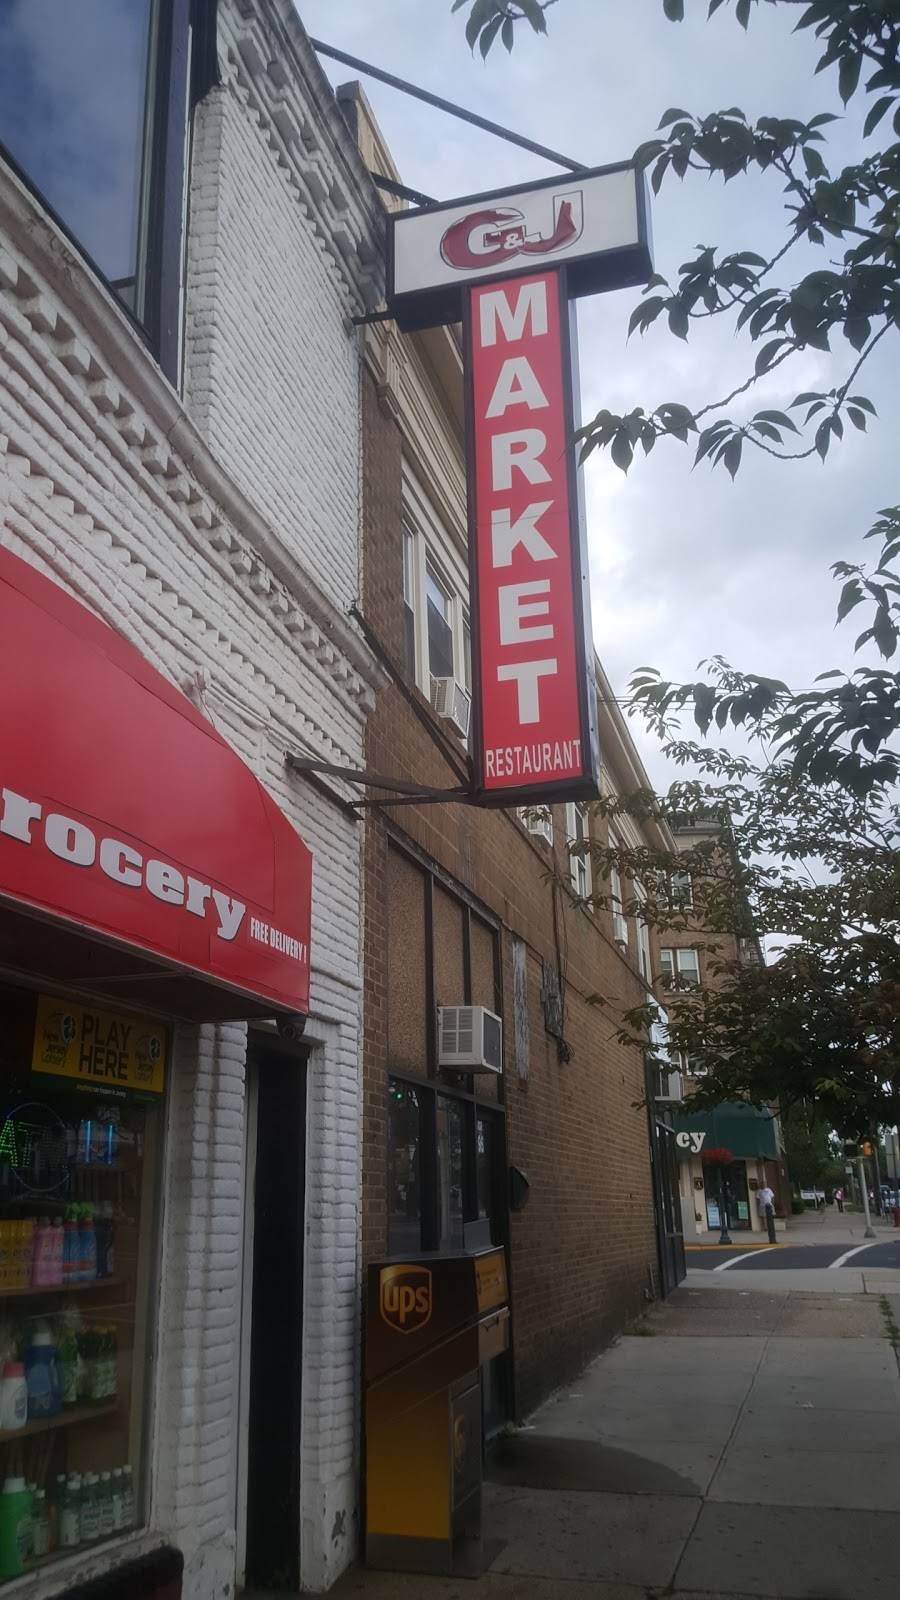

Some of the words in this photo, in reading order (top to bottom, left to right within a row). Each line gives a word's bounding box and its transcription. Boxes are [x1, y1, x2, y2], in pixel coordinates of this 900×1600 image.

[479, 280, 558, 724] MARKET
[485, 740, 581, 778] RESTAURANT
[0, 788, 246, 940] rocery
[250, 917, 269, 945] FREE
[80, 1013, 131, 1052] PLAY
[78, 1043, 129, 1081] HERE
[676, 1131, 706, 1153] cy
[383, 1285, 429, 1324] ups
